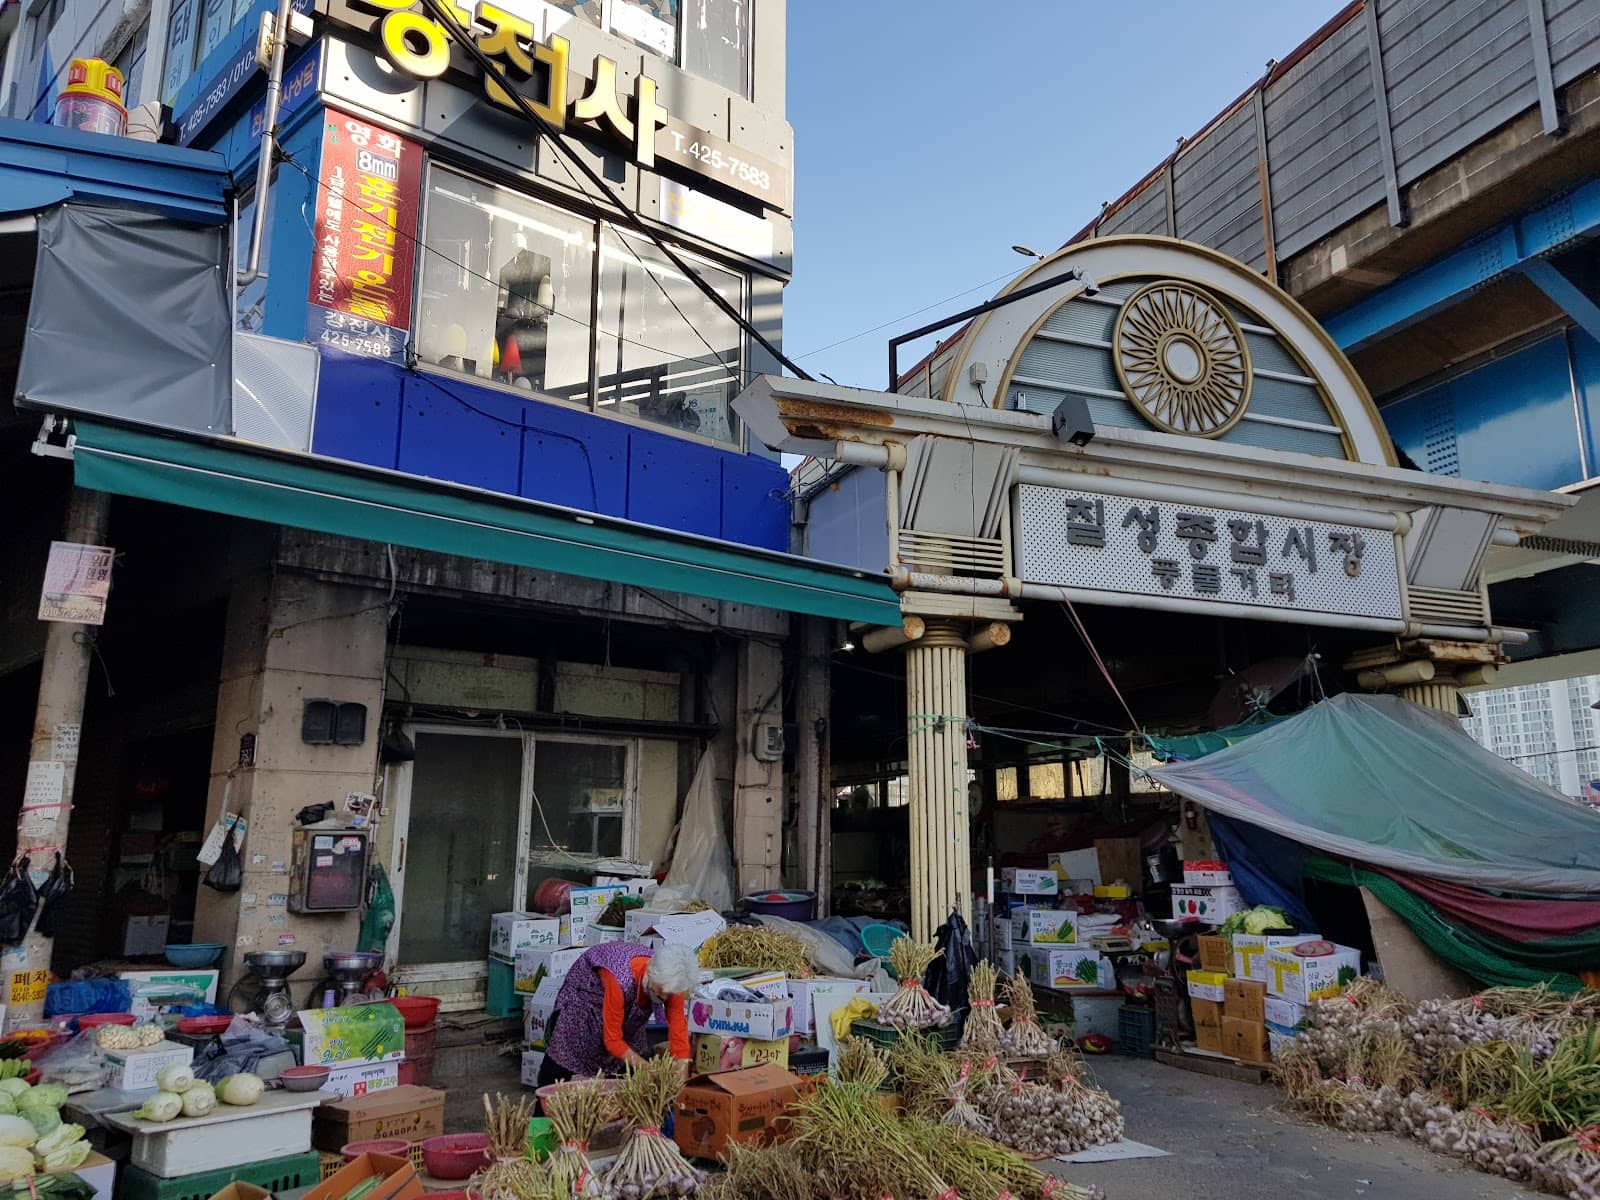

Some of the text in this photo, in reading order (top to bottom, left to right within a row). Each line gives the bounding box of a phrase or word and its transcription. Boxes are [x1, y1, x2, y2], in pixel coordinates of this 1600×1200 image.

[359, 151, 397, 179] 8mm
[321, 329, 391, 358] 425-7583
[1065, 497, 1367, 578] 칠성종합시장
[708, 1019, 750, 1034] PAPRIKA
